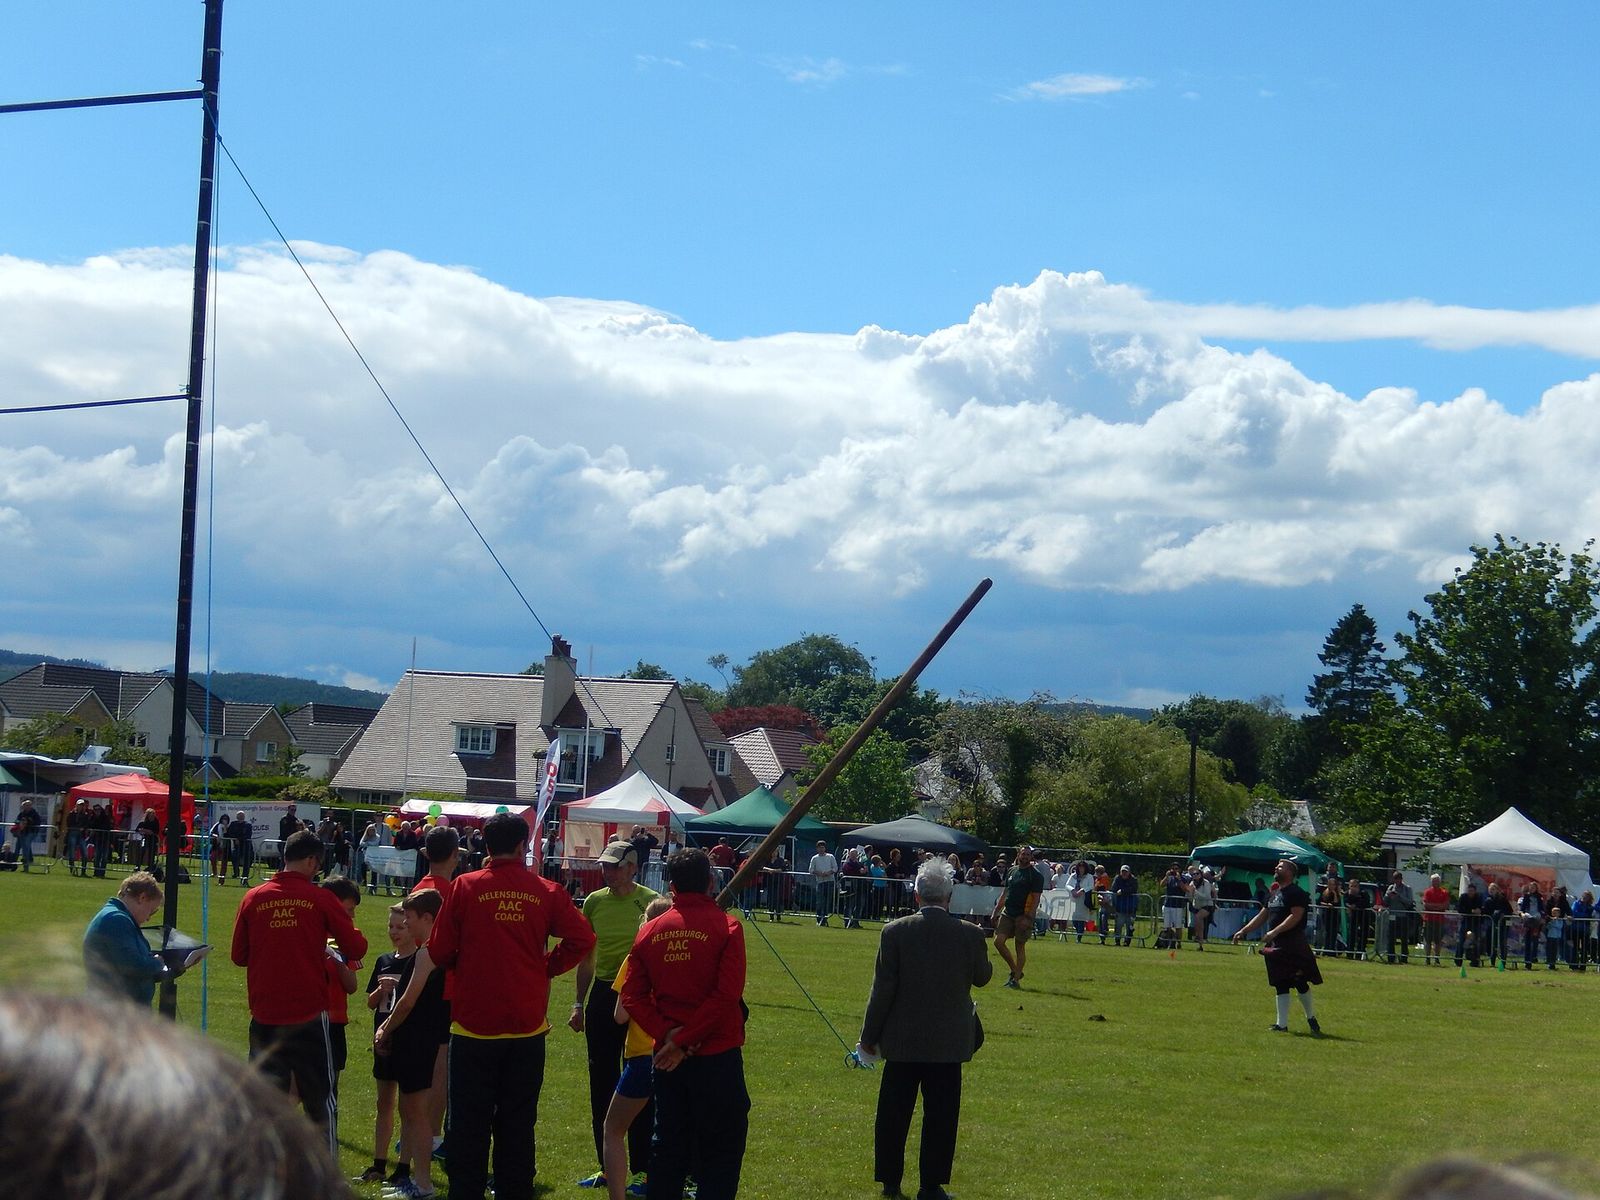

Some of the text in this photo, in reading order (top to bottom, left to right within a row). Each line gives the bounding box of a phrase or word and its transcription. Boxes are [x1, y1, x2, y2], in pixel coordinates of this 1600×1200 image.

[252, 824, 270, 832] outs
[478, 891, 541, 905] HELENSBURGH
[256, 899, 314, 912] HELENSBURGH
[498, 900, 522, 911] AAC
[273, 908, 295, 918] AAC
[494, 912, 525, 921] COACH
[269, 919, 298, 928] COACH
[651, 930, 709, 944] HELENSBURGH
[667, 940, 689, 951] AAC
[664, 952, 691, 962] COACH
